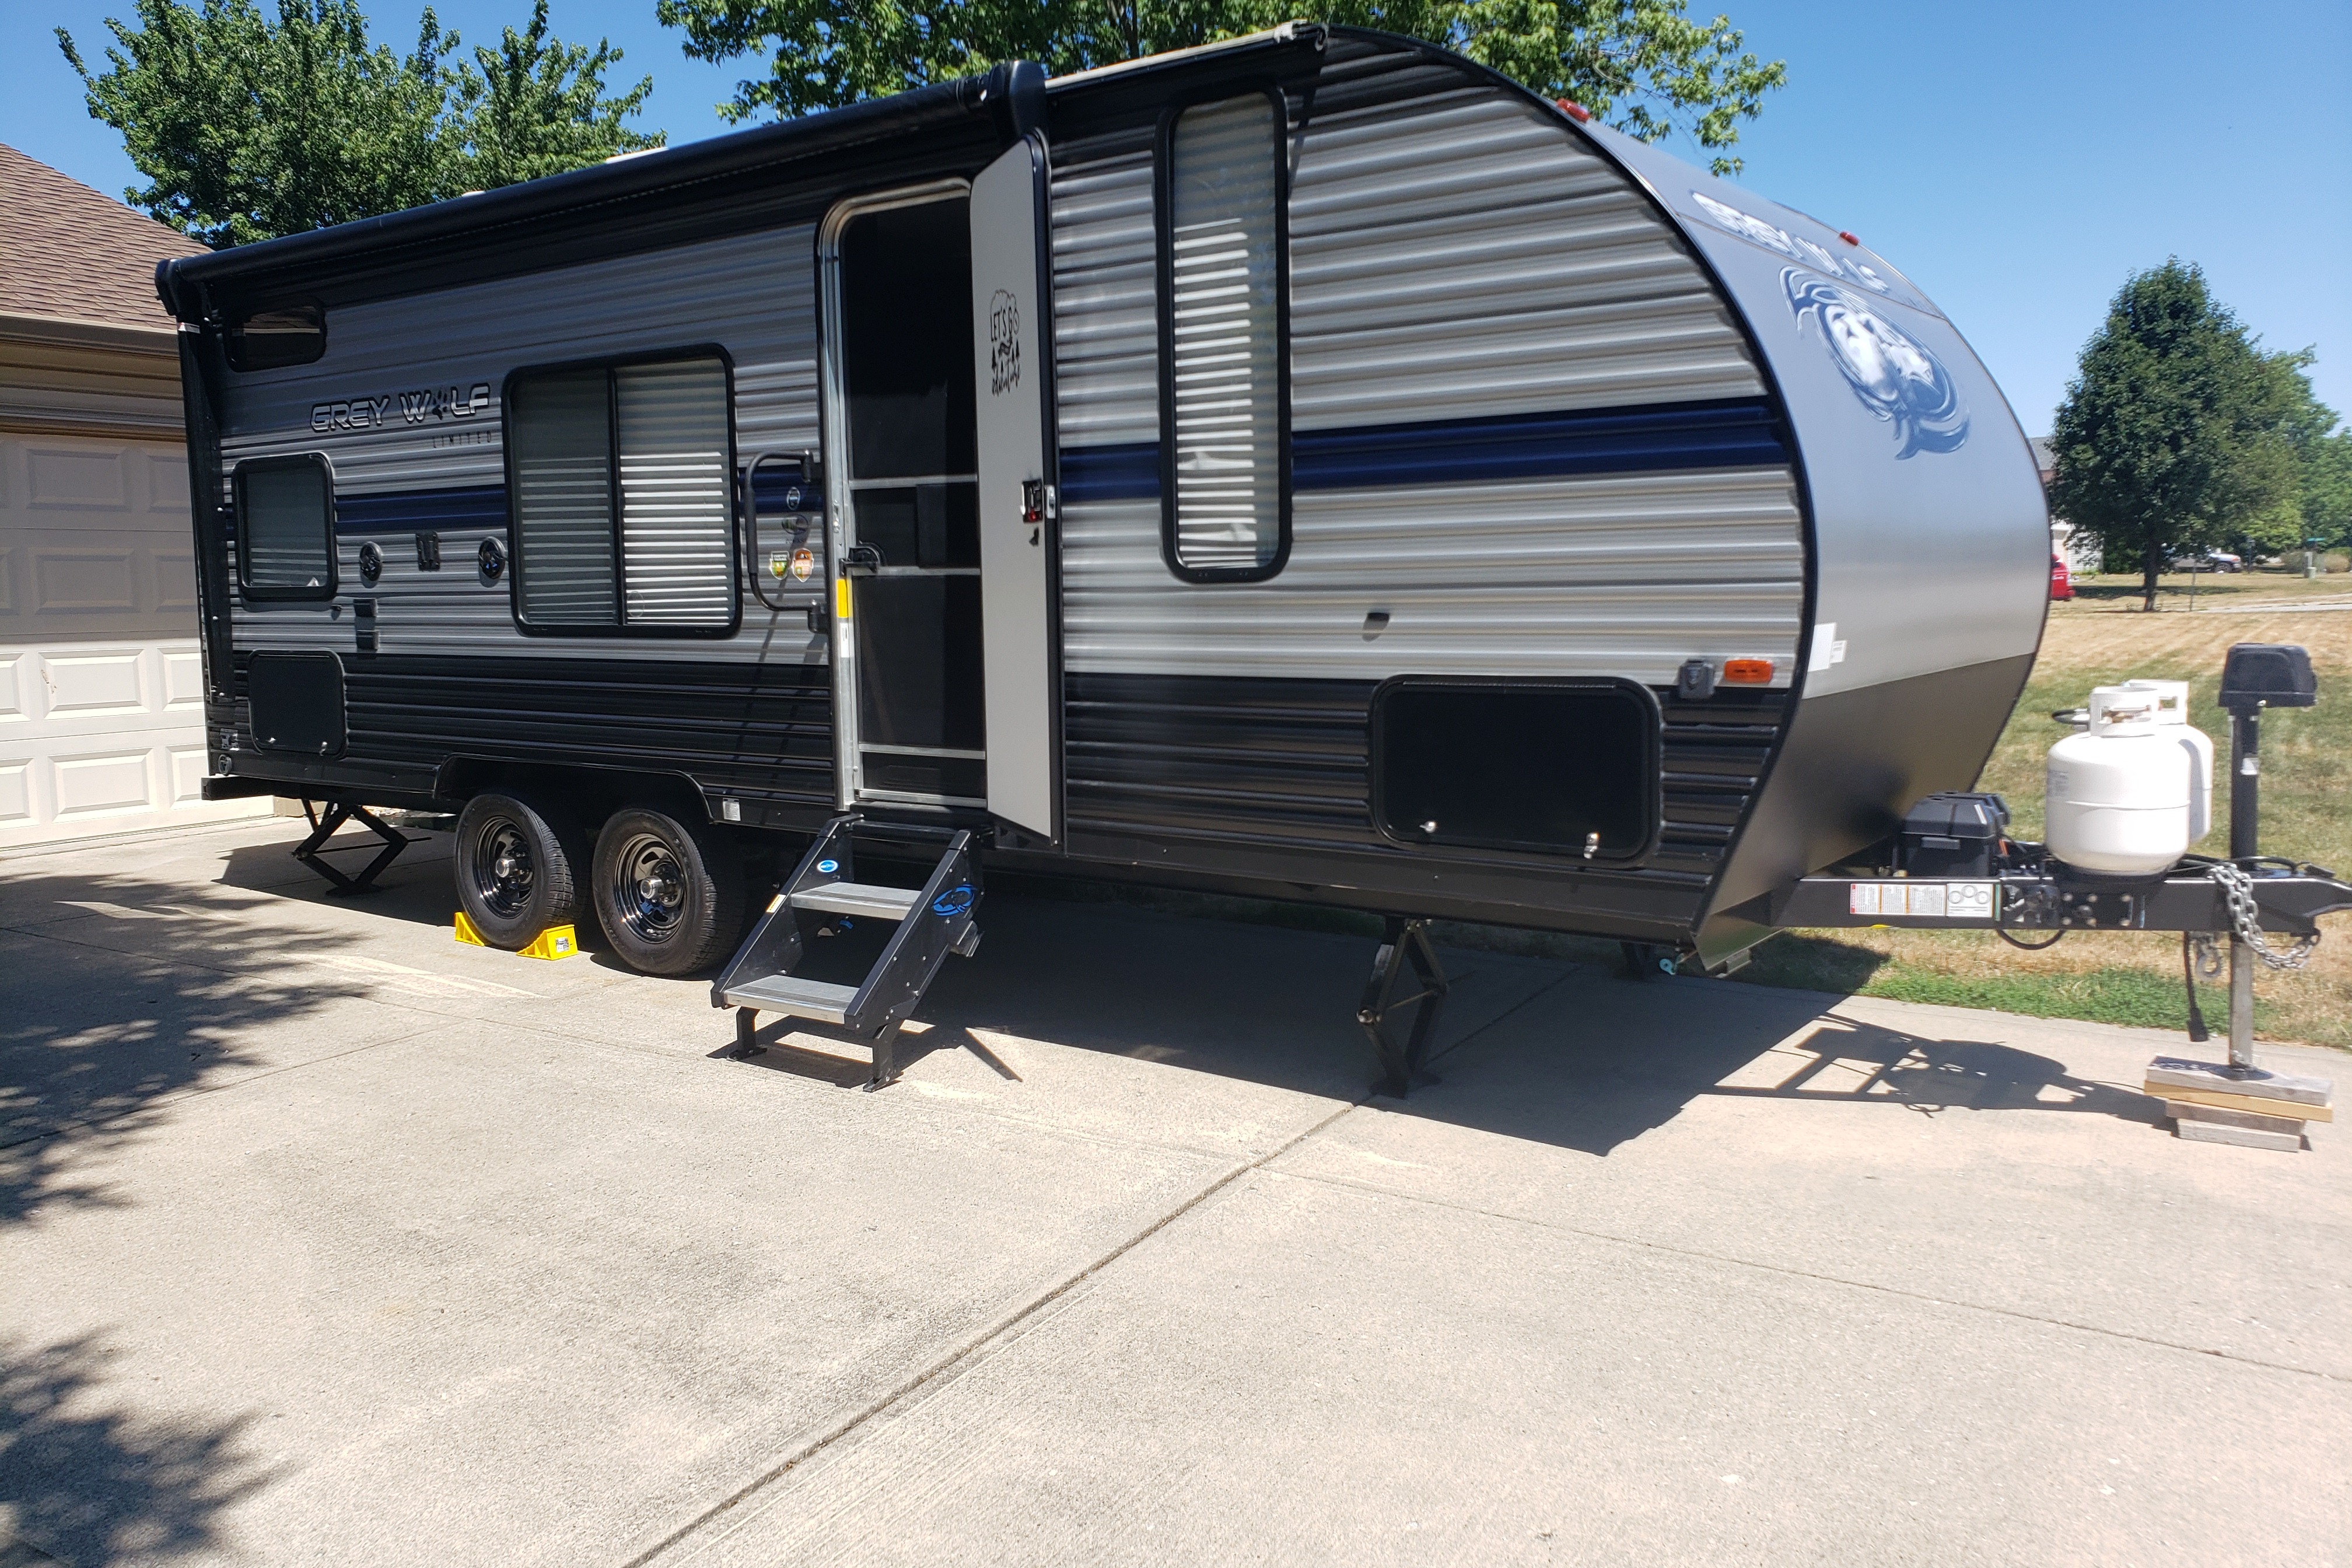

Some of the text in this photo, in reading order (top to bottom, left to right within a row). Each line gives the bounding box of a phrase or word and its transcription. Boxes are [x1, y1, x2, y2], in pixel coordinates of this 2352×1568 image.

[1794, 236, 1889, 292] WLF
[991, 306, 1007, 342] LET'S
[310, 383, 491, 432] GREY WLF
[433, 430, 492, 449] LIMITED
